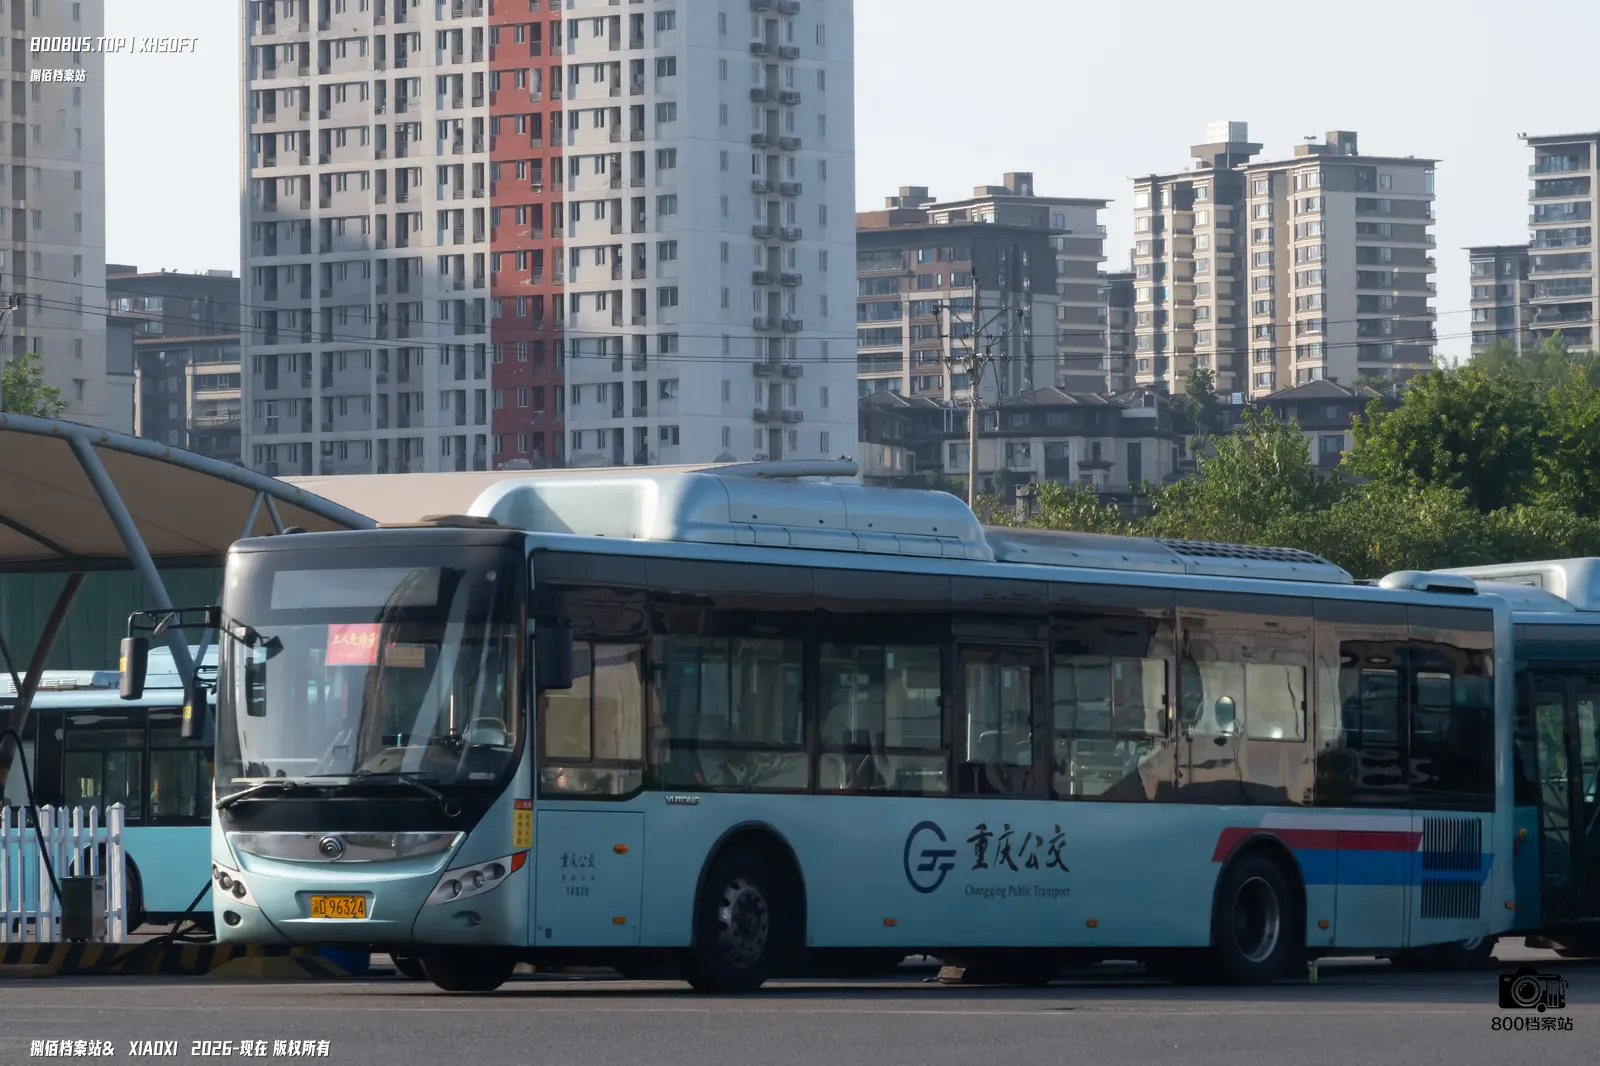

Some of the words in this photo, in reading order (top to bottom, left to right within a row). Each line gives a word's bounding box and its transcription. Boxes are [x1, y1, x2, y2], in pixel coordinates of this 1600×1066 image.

[664, 795, 701, 806] YUTONG
[966, 822, 1071, 873] 重庆公交
[559, 852, 597, 869] 重庆公交
[964, 884, 1007, 900] Chongqing
[1008, 885, 1031, 897] Public
[1033, 885, 1071, 900] Transport
